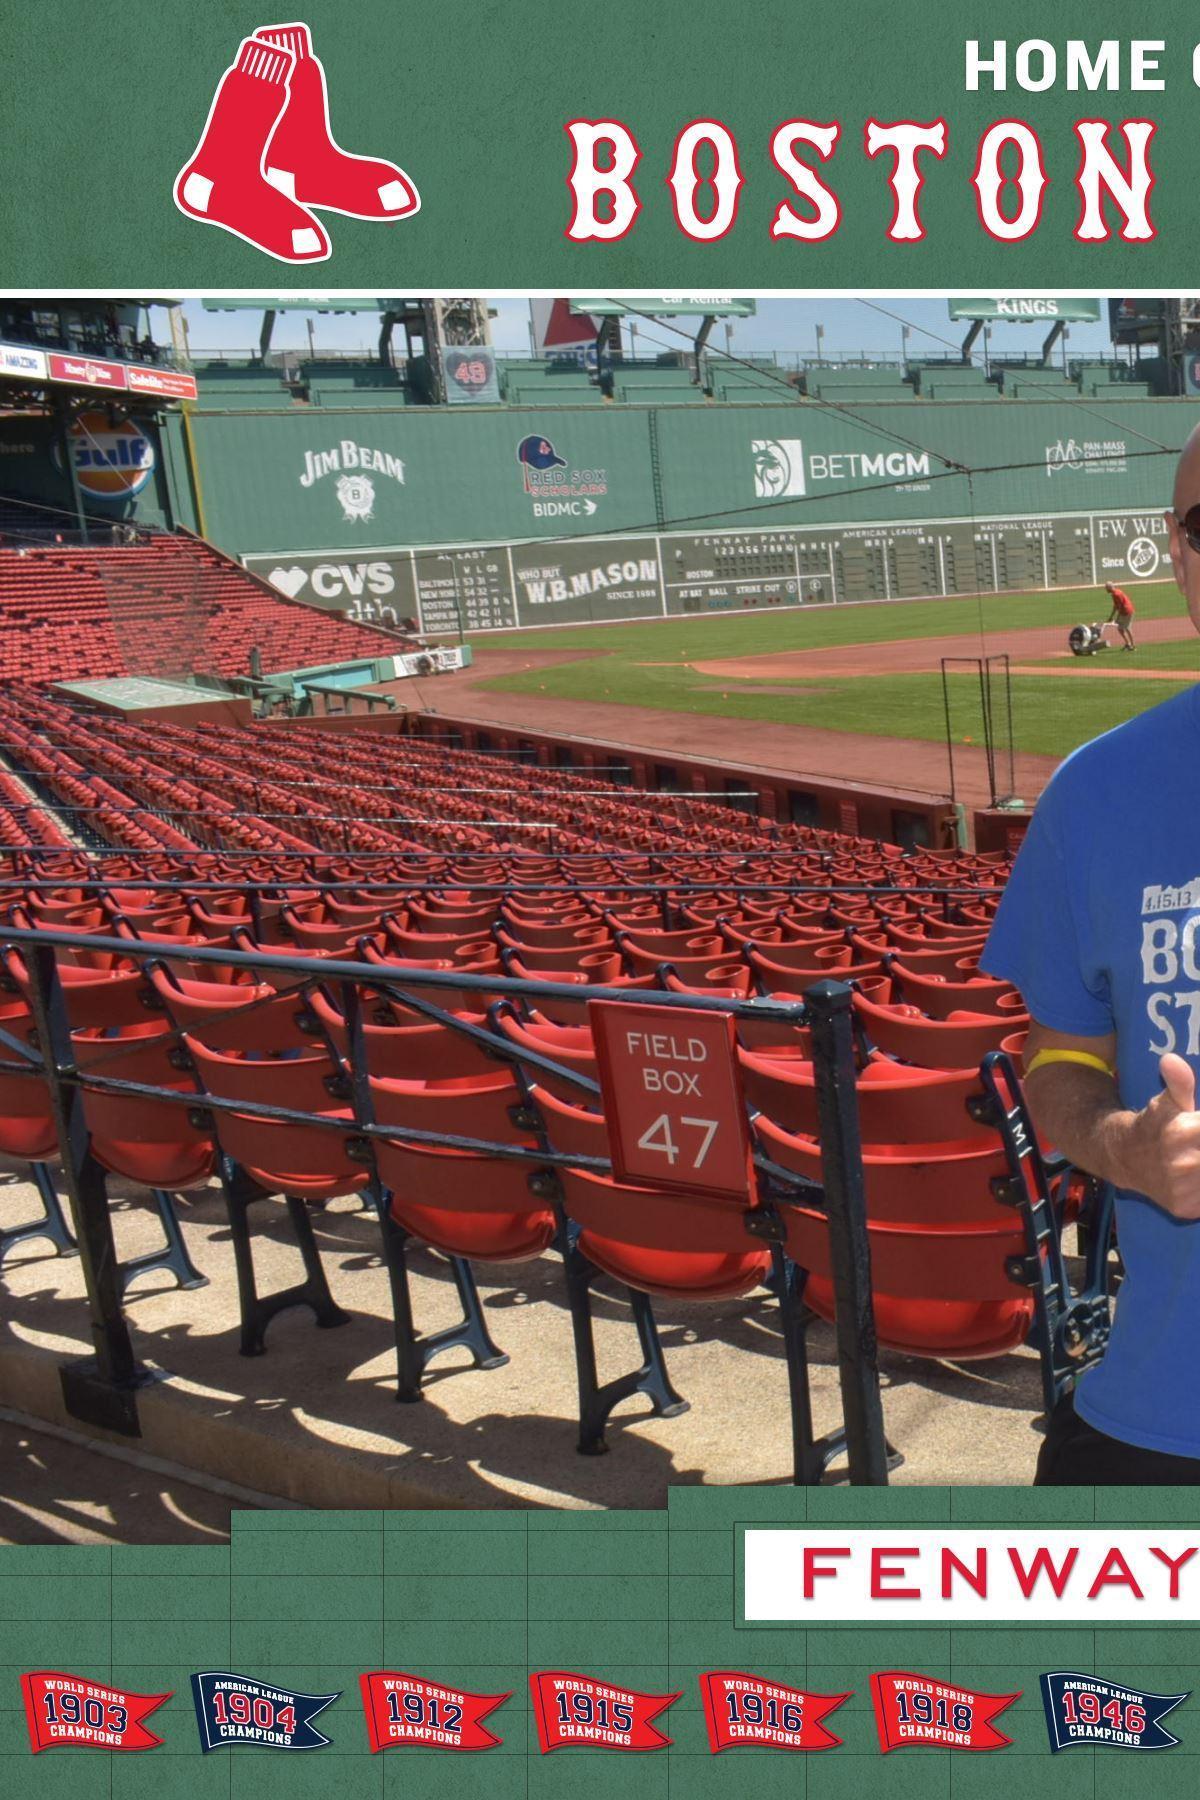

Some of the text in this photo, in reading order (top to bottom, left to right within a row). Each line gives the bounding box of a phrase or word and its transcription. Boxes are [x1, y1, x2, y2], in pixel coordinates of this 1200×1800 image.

[299, 440, 406, 488] JIM BEAM
[808, 451, 930, 479] BETMGM
[531, 469, 608, 485] RED SOX
[531, 484, 608, 497] SCHOLARS
[533, 501, 581, 517] BIDMC
[694, 533, 797, 547] FENWAY PARK
[842, 527, 925, 539] AMERICAN LEAGUE
[456, 550, 487, 560] EAST
[311, 562, 396, 598] CVS
[517, 567, 561, 581] WHO BUT
[422, 600, 454, 610] BOSTON
[1144, 890, 1193, 911] 4.15.13
[626, 1031, 708, 1062] FIELD
[643, 1067, 702, 1097] BOX
[637, 1113, 719, 1169] 47
